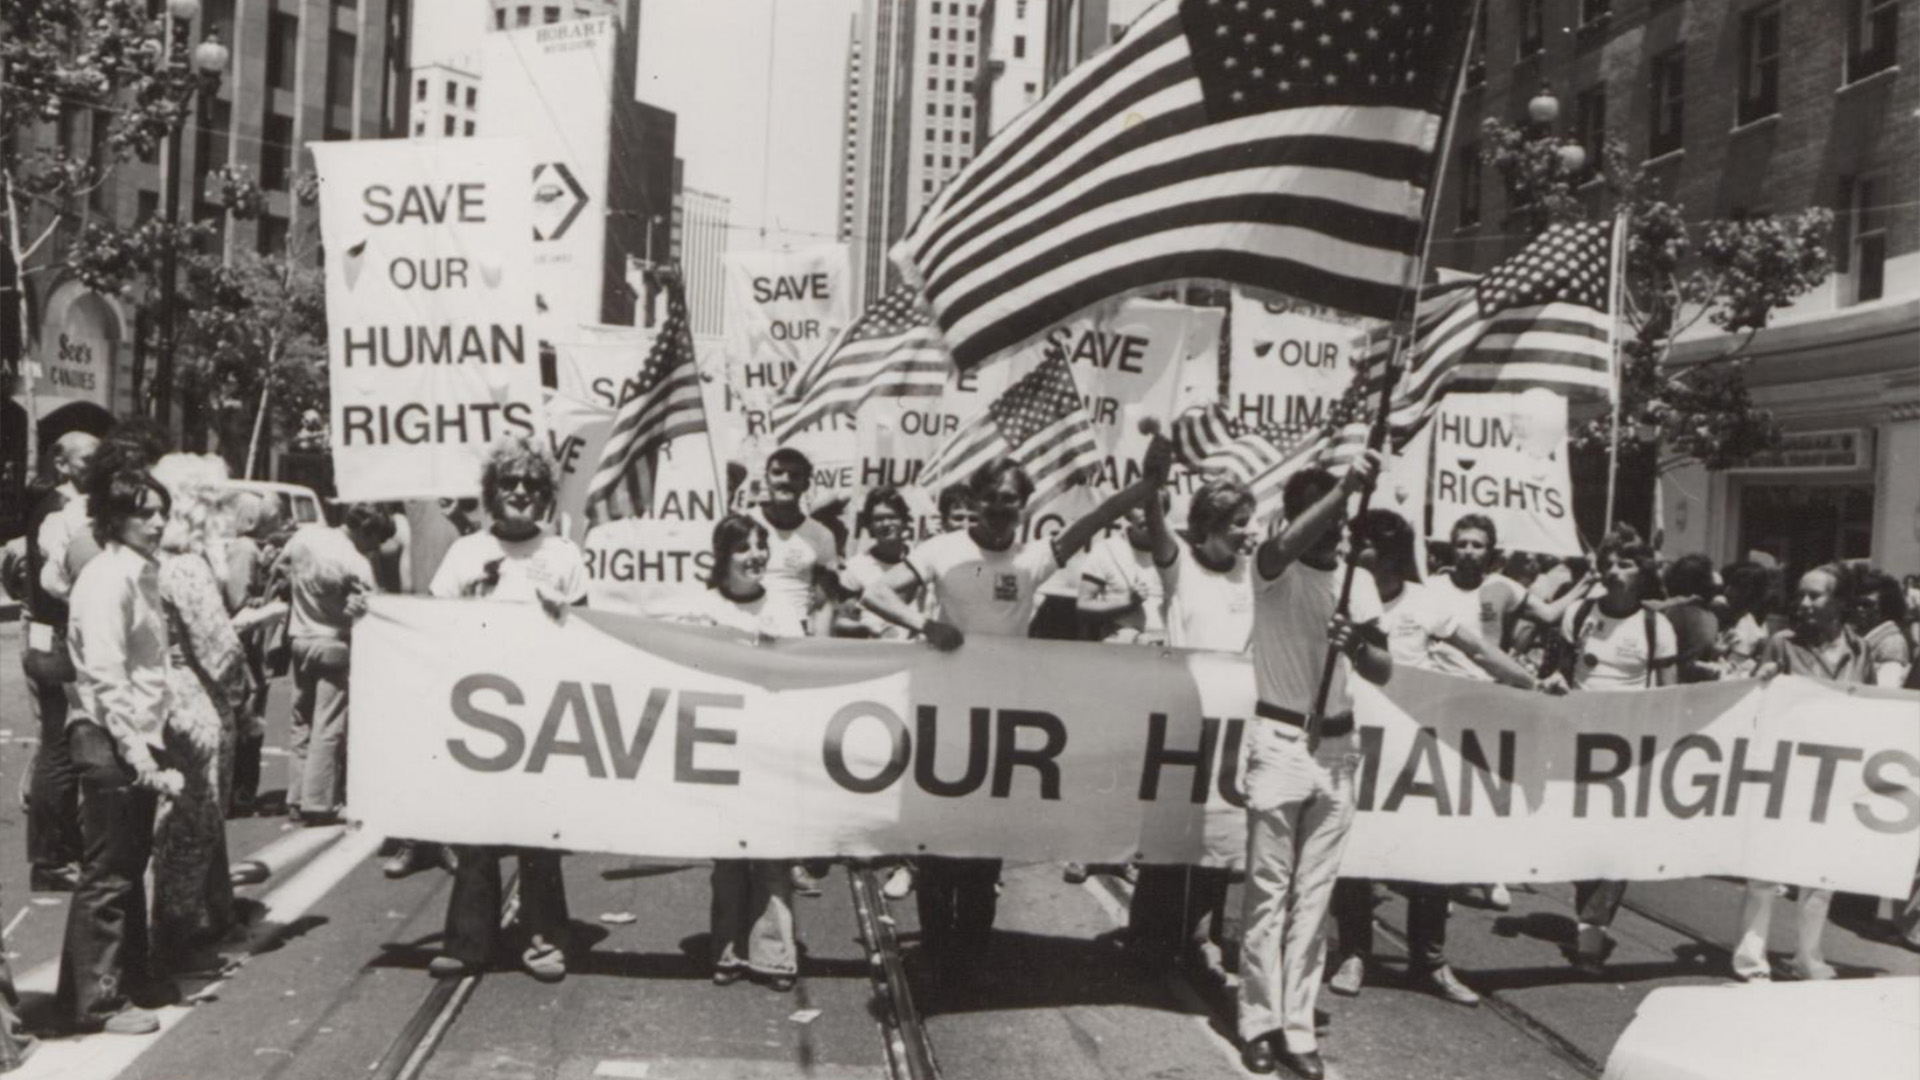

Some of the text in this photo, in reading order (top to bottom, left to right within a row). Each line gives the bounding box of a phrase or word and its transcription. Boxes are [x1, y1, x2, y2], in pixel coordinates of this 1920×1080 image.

[363, 183, 487, 226] SAVE
[388, 257, 469, 290] OUR
[752, 273, 830, 304] SAVE
[344, 324, 525, 368] HUMAN
[770, 319, 820, 341] OUR
[1044, 326, 1149, 374] SAVE
[1279, 339, 1339, 370] OUR
[592, 377, 647, 410] SA
[1083, 395, 1120, 426] UR
[1240, 393, 1324, 430] HUM
[343, 402, 535, 446] RIGHTS
[900, 410, 960, 437] OUR
[1441, 411, 1530, 452] HUM
[548, 428, 586, 475] VE
[813, 466, 854, 489] AVE
[1438, 469, 1566, 519] RIGHTS
[446, 673, 745, 786] SAVE
[823, 700, 1068, 801] OUR
[1574, 732, 1919, 834] RIGHTS
